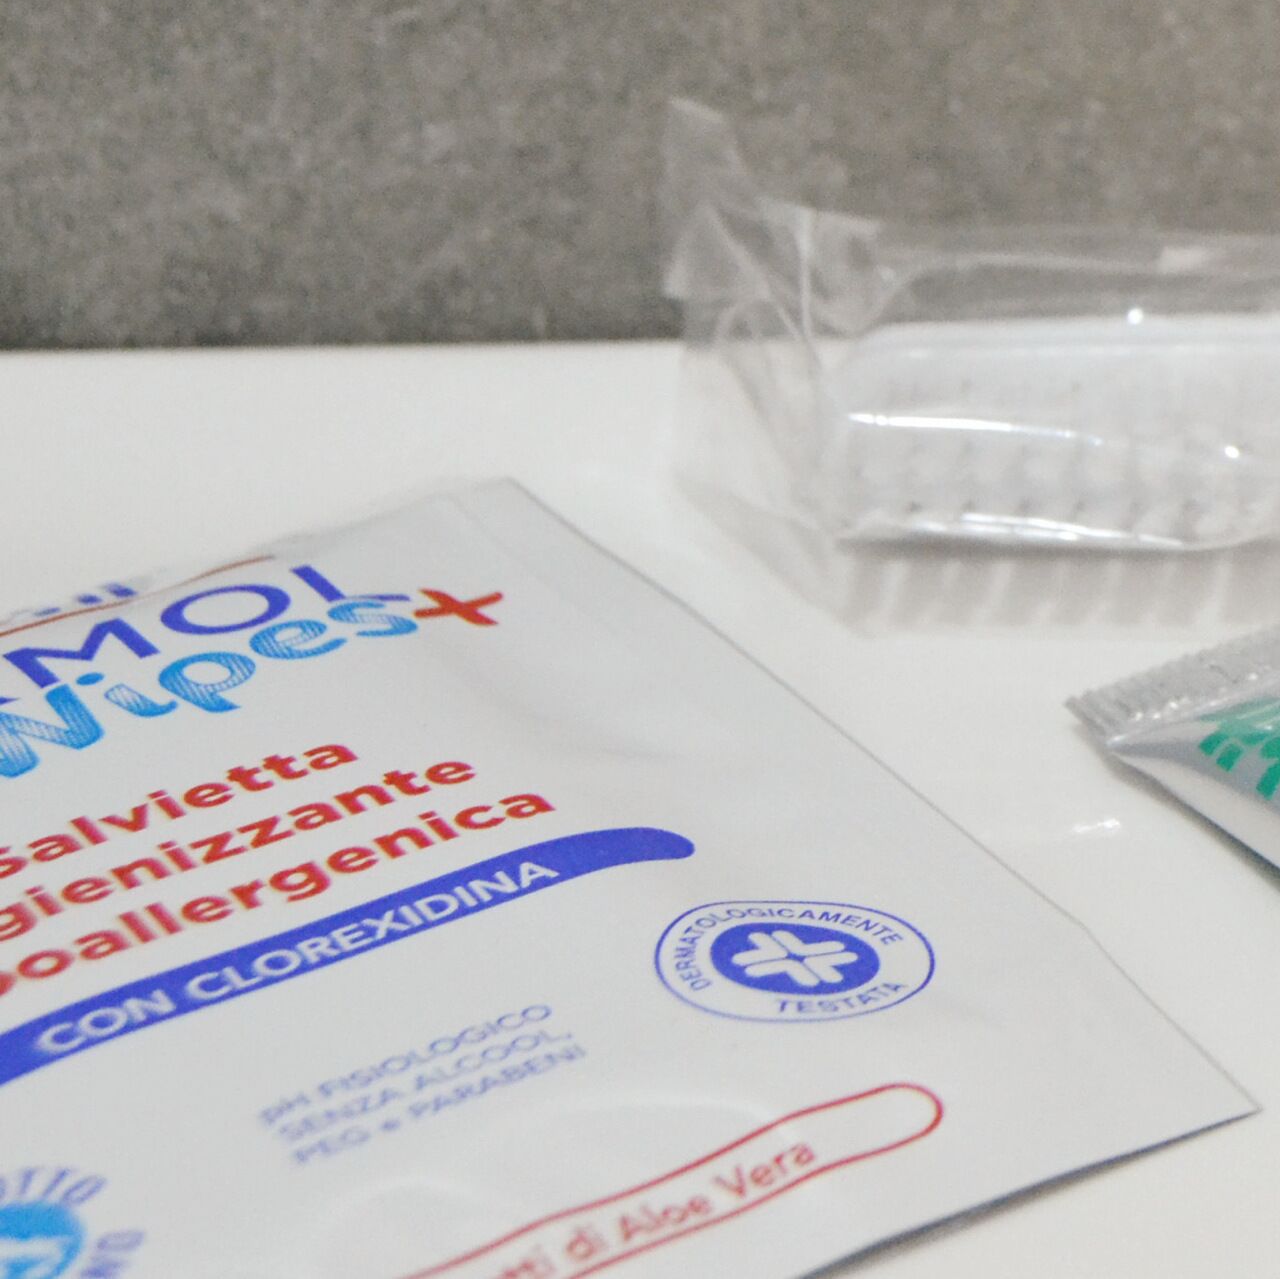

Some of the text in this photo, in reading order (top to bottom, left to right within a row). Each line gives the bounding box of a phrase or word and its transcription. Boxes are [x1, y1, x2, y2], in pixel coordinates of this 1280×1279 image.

[0, 565, 411, 706] MOL
[36, 861, 560, 1053] CON CLOREXIDINA
[674, 907, 904, 992] DERMATOLOGICAMENTE
[777, 982, 907, 1013] TESTATA
[317, 1004, 552, 1099] FISIOLOGICO
[618, 1195, 713, 1243] Aloe
[713, 1142, 817, 1199] Vera
